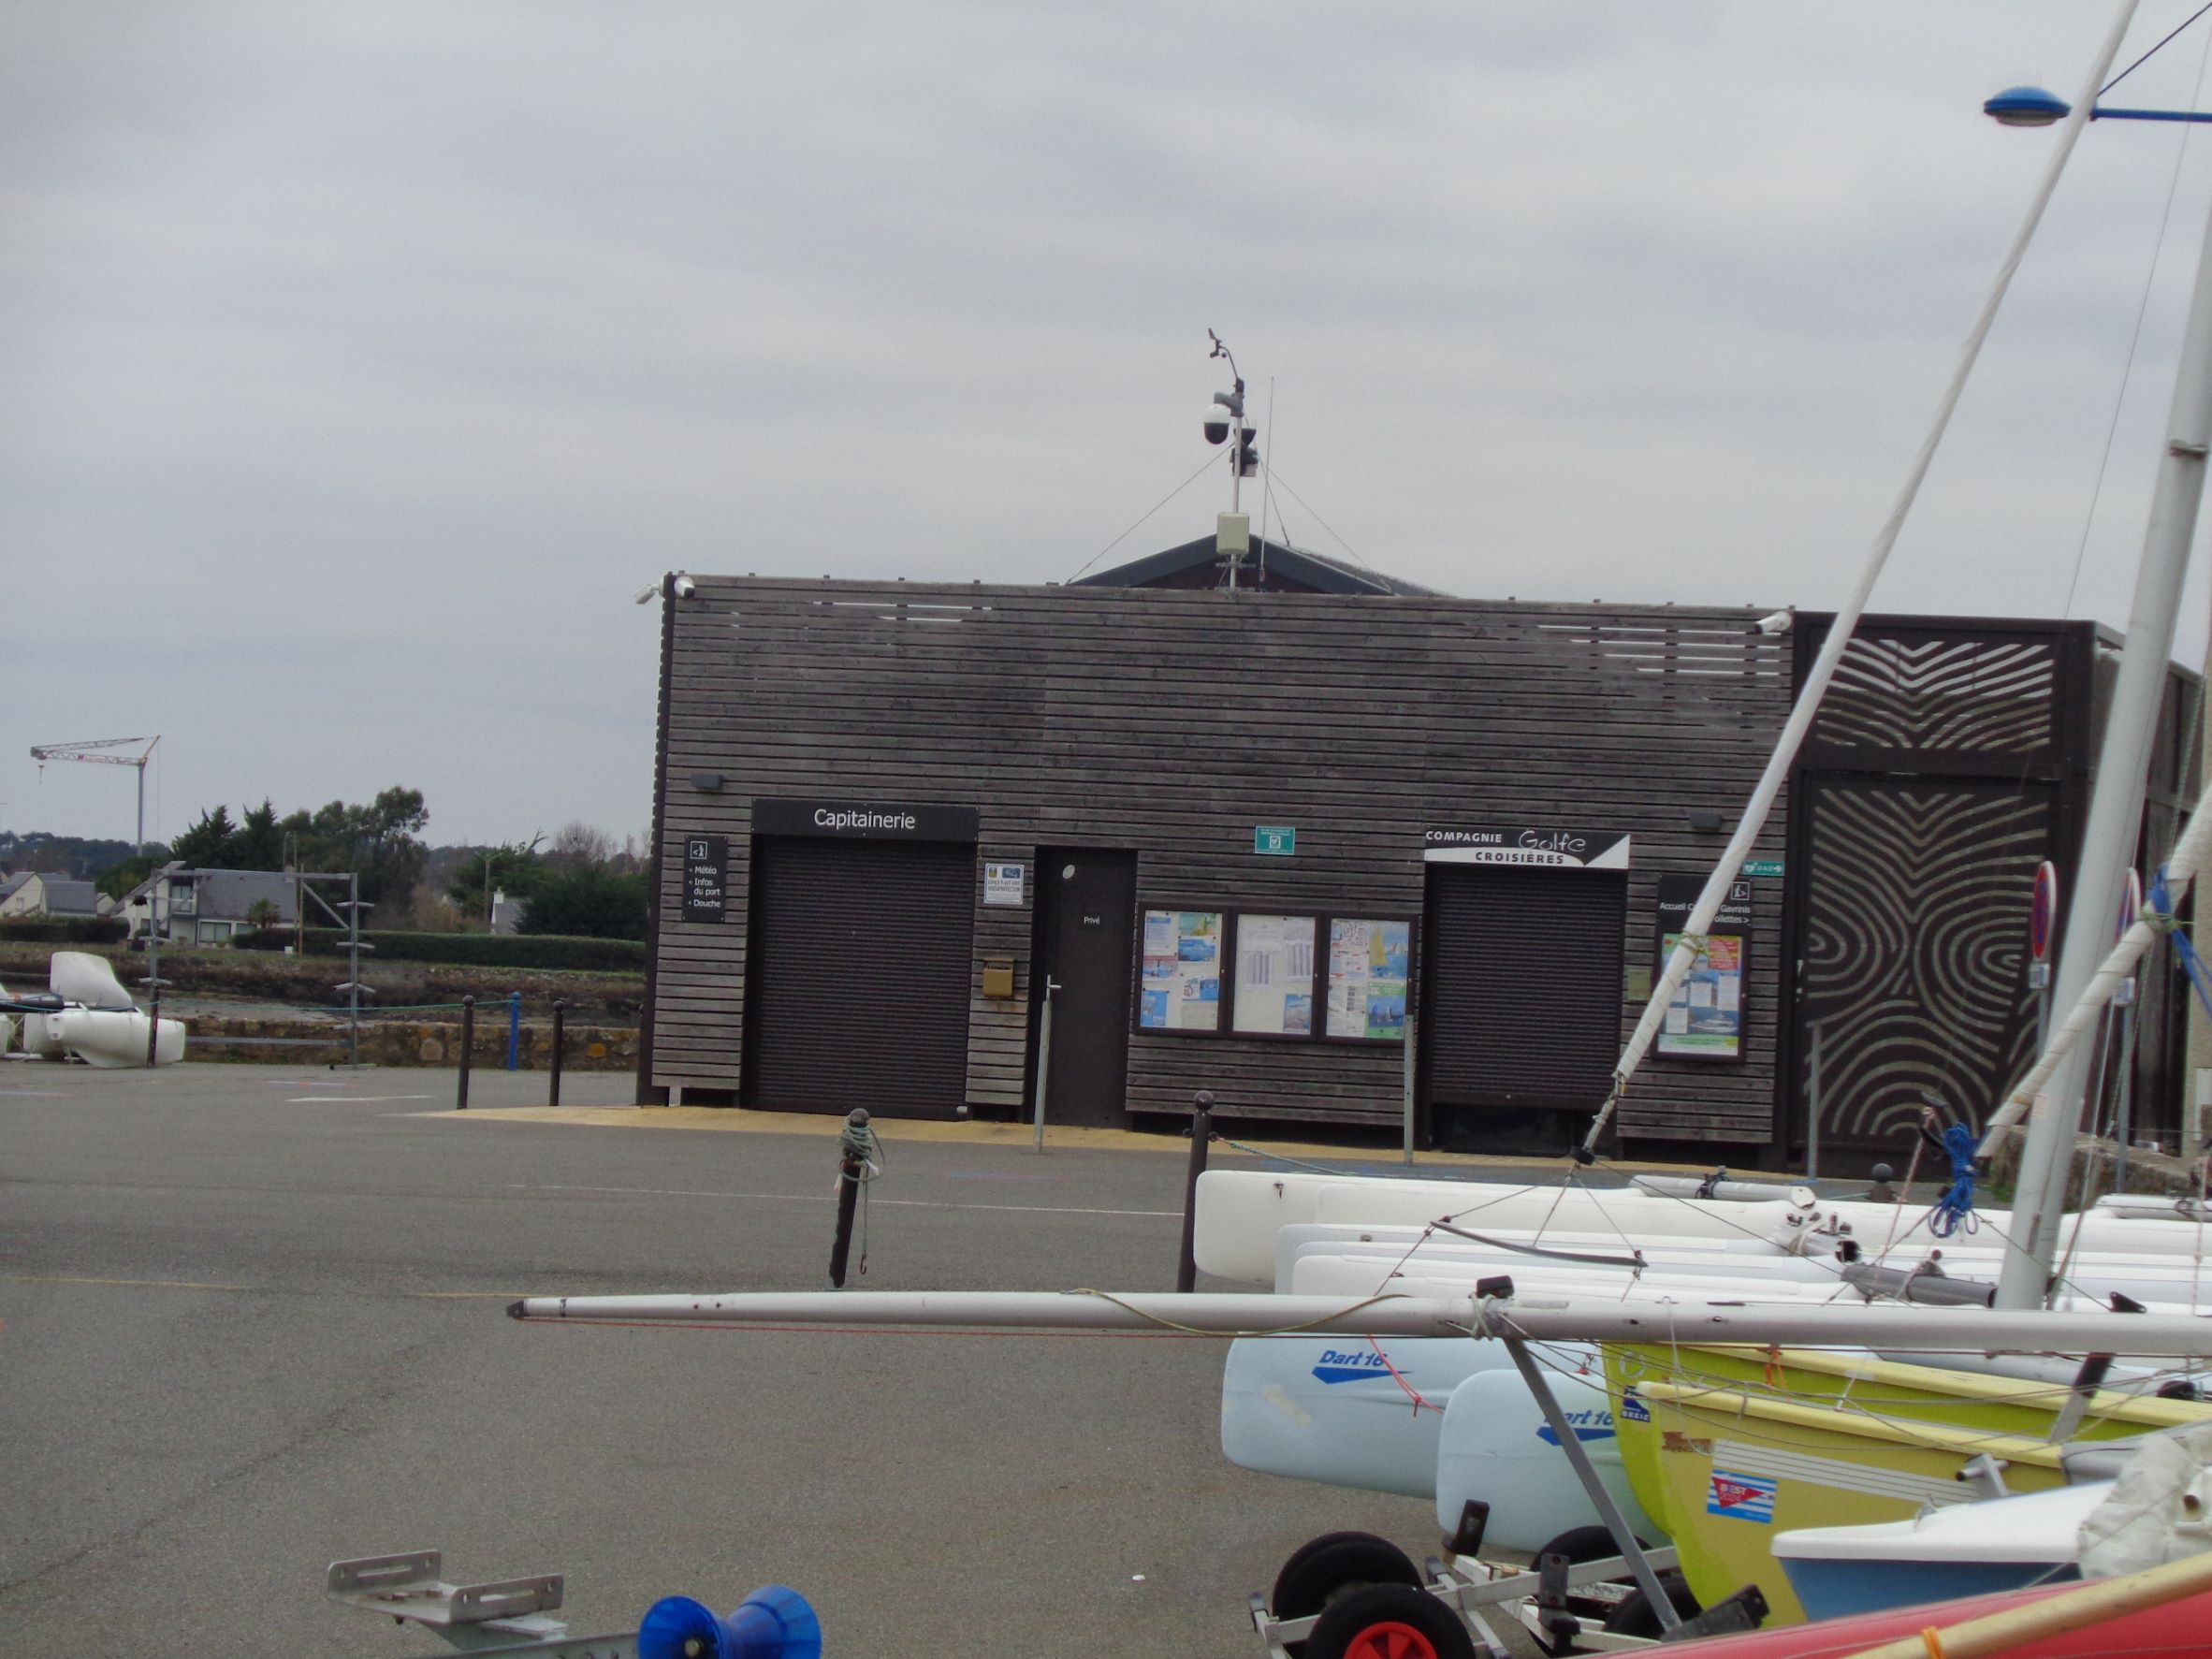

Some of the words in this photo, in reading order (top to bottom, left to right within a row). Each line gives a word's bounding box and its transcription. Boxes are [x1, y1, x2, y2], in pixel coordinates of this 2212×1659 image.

[814, 808, 916, 830] Capitainerie
[1425, 830, 1502, 842] COMPAGNIE
[1518, 829, 1586, 852] Golfe
[1475, 851, 1564, 865] CROISIÈRES
[694, 866, 717, 875] Météo
[694, 878, 713, 886] Infos
[693, 887, 704, 895] du
[705, 888, 720, 896] port
[693, 898, 721, 908] Douche
[1659, 902, 1685, 911] Accueil
[1720, 905, 1752, 914] Gavrinis
[1084, 915, 1100, 924] Privé
[1714, 915, 1742, 924] oilettes
[1318, 1350, 1363, 1365] Dart
[1364, 1353, 1388, 1367] 16
[1543, 1409, 1593, 1425] art
